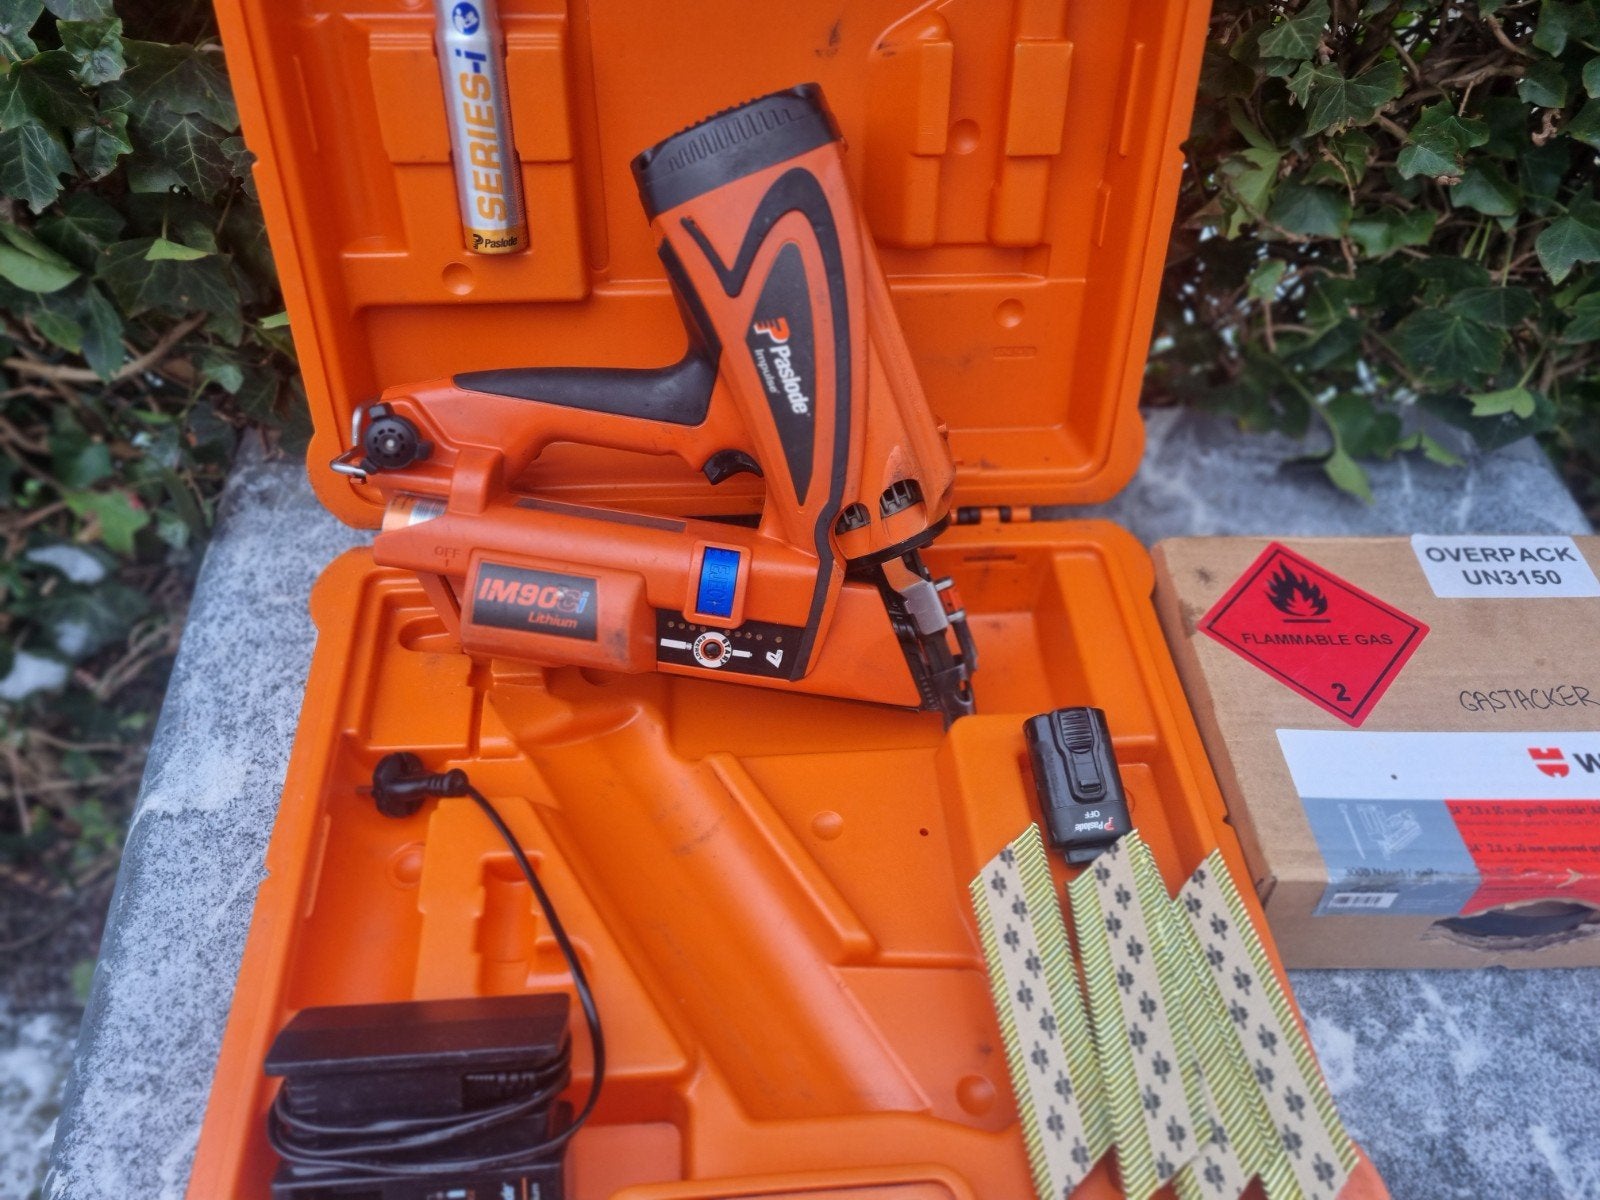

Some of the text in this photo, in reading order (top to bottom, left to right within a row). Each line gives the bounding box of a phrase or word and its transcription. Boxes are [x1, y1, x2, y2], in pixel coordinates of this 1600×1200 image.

[455, 48, 507, 221] SERIES-i
[485, 237, 517, 248] Paslode
[755, 349, 777, 393] Impulse
[769, 345, 809, 414] Paslode
[434, 546, 461, 558] OFF
[1425, 546, 1577, 563] OVERPACK
[1462, 569, 1562, 585] UN3150
[528, 611, 578, 629] Lithium
[1241, 632, 1394, 646] FLAMMABLE GAS
[720, 637, 732, 664] START
[1331, 682, 1352, 702] 2
[1459, 685, 1600, 712] GASTACKER
[1084, 809, 1100, 819] OFF
[1075, 820, 1104, 832] Paslode
